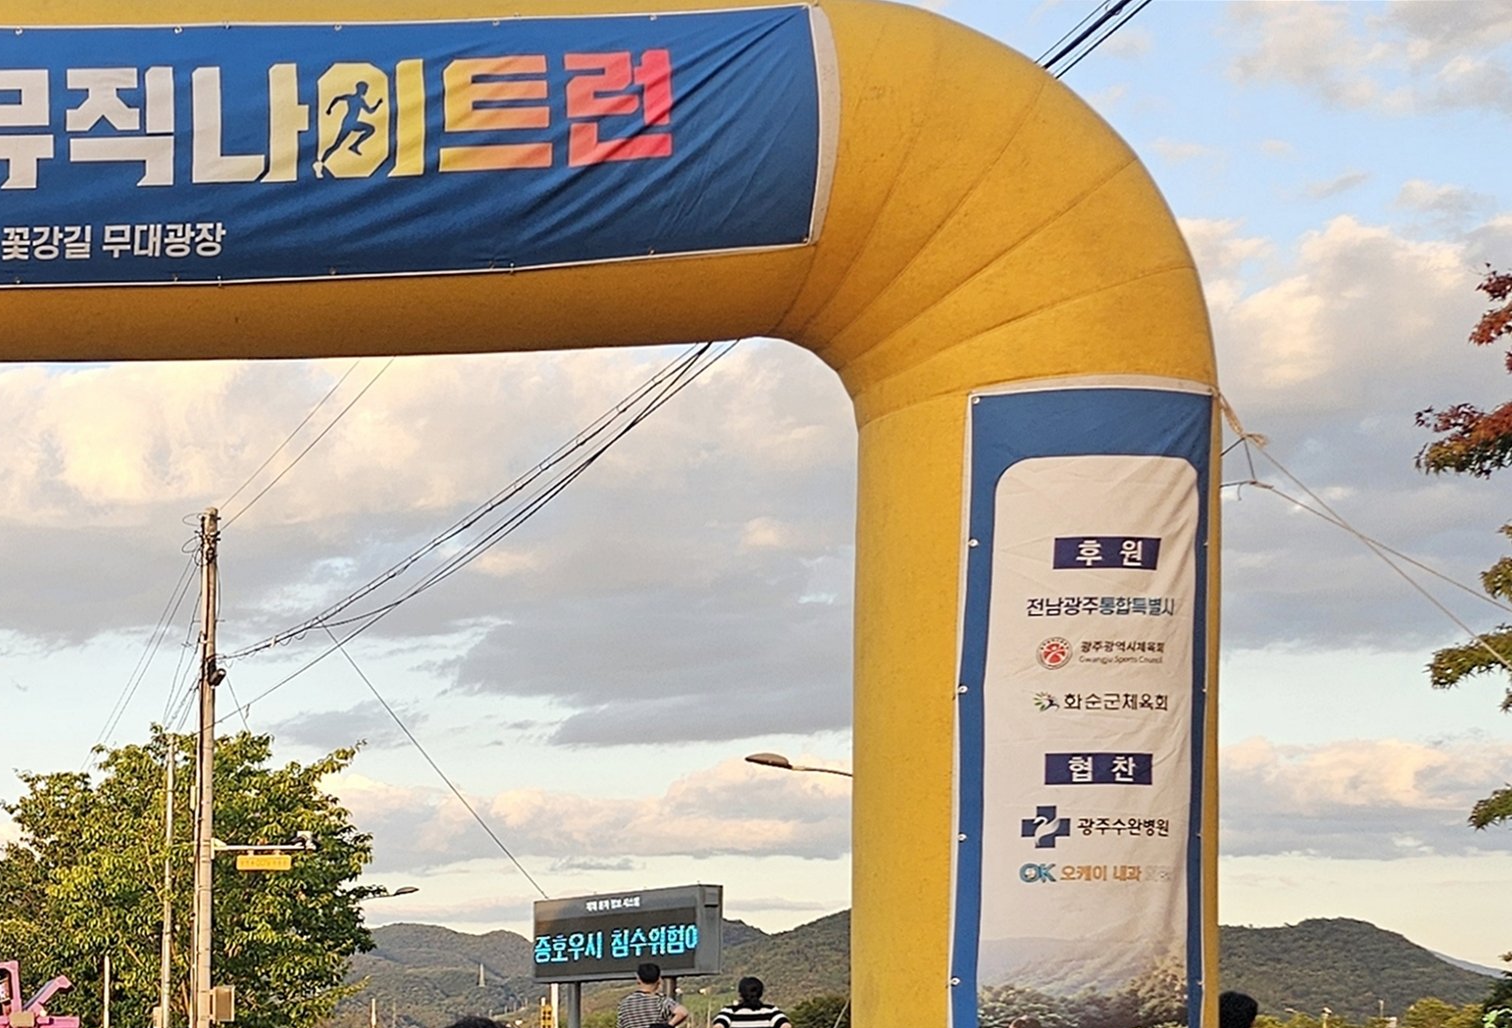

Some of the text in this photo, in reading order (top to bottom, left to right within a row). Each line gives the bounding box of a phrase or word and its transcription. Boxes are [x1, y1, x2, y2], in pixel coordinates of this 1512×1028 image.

[1, 225, 93, 261] 꽃강길
[102, 222, 227, 259] 무대광장
[1027, 596, 1175, 617] 전남광주통합특별시
[1063, 693, 1169, 712] 화순군체육회
[1076, 818, 1170, 837] 광주수완병원
[1019, 863, 1057, 883] OK
[1060, 865, 1108, 881] 오케이
[1113, 865, 1142, 881] 내과
